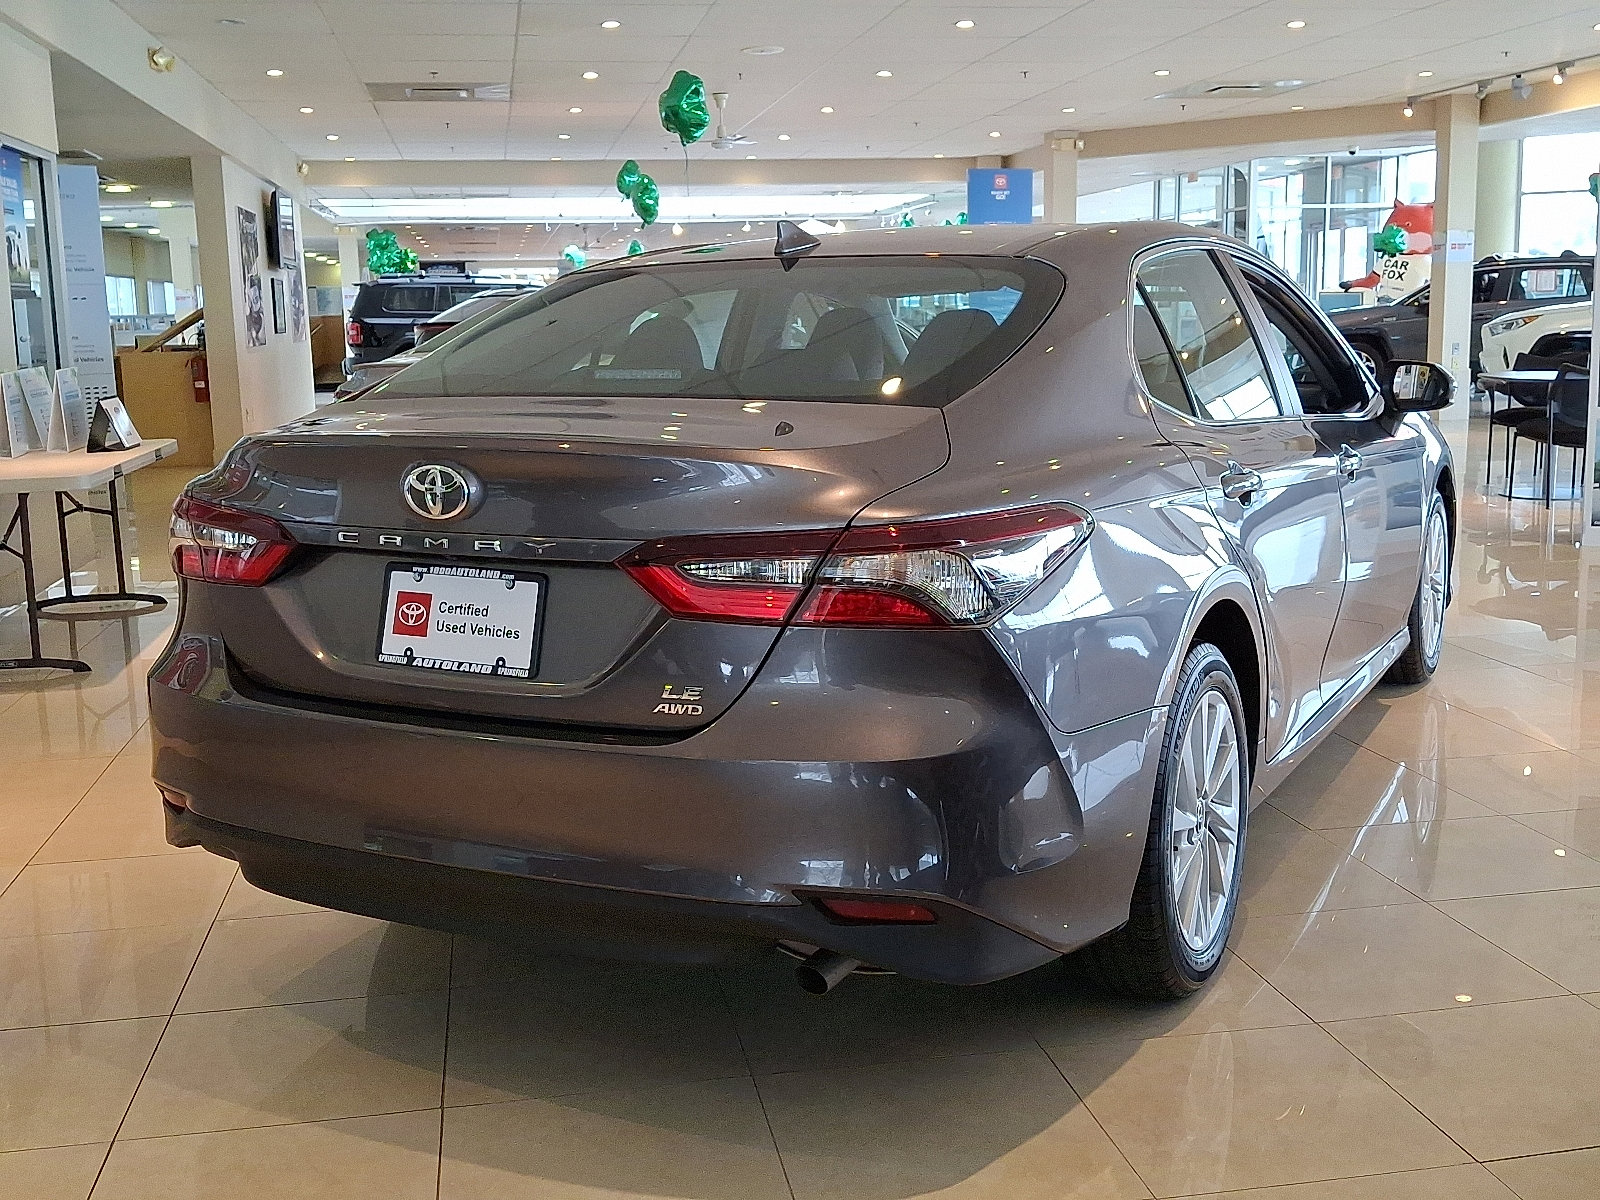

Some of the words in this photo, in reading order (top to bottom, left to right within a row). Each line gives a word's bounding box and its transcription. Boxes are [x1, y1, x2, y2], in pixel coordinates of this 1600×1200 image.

[1383, 259, 1410, 271] CAR
[1382, 269, 1406, 281] FOX
[337, 531, 557, 554] CAMRY
[438, 601, 489, 618] Certified
[436, 619, 467, 635] Used
[470, 622, 520, 640] Vehicles
[412, 657, 492, 674] AUTOLAND
[661, 684, 704, 700] LE
[652, 703, 704, 716] AWD
